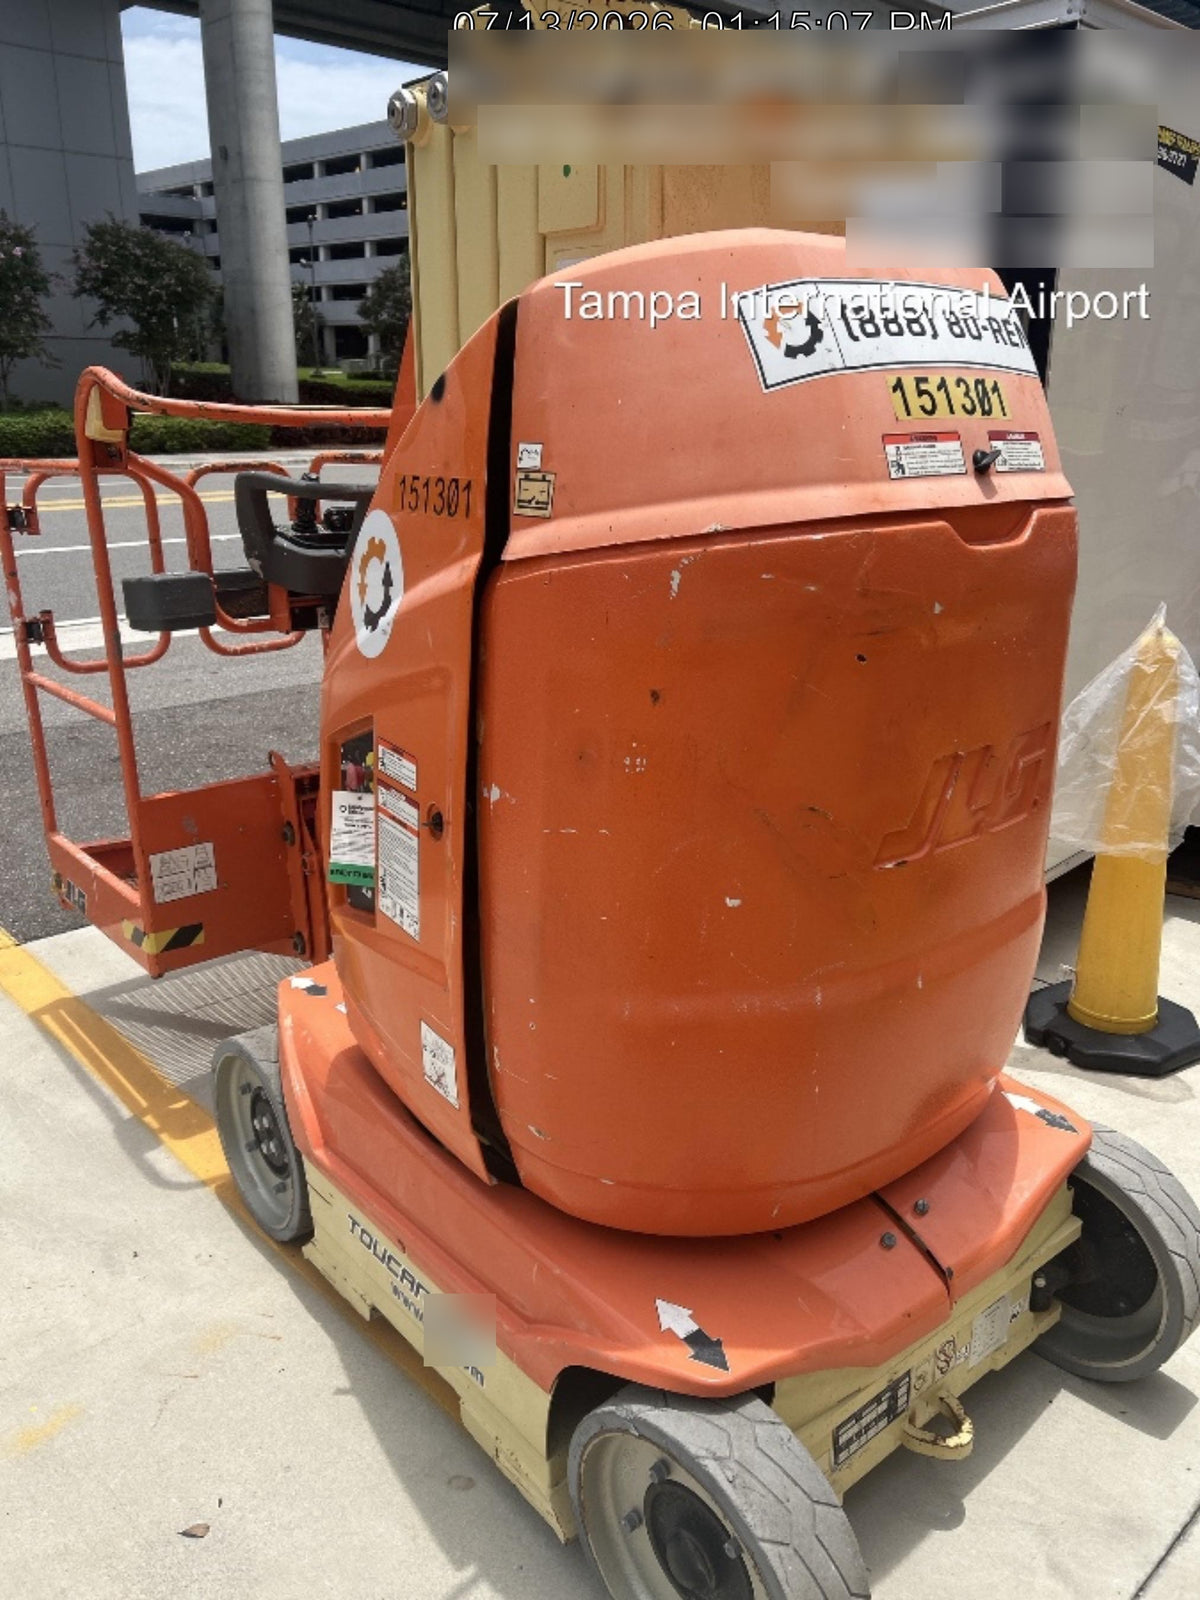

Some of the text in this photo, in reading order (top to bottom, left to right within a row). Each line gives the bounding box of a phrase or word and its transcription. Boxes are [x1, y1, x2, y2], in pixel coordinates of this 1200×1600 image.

[891, 376, 1008, 417] 151301
[399, 475, 472, 518] 151301
[872, 721, 1052, 870] JLG
